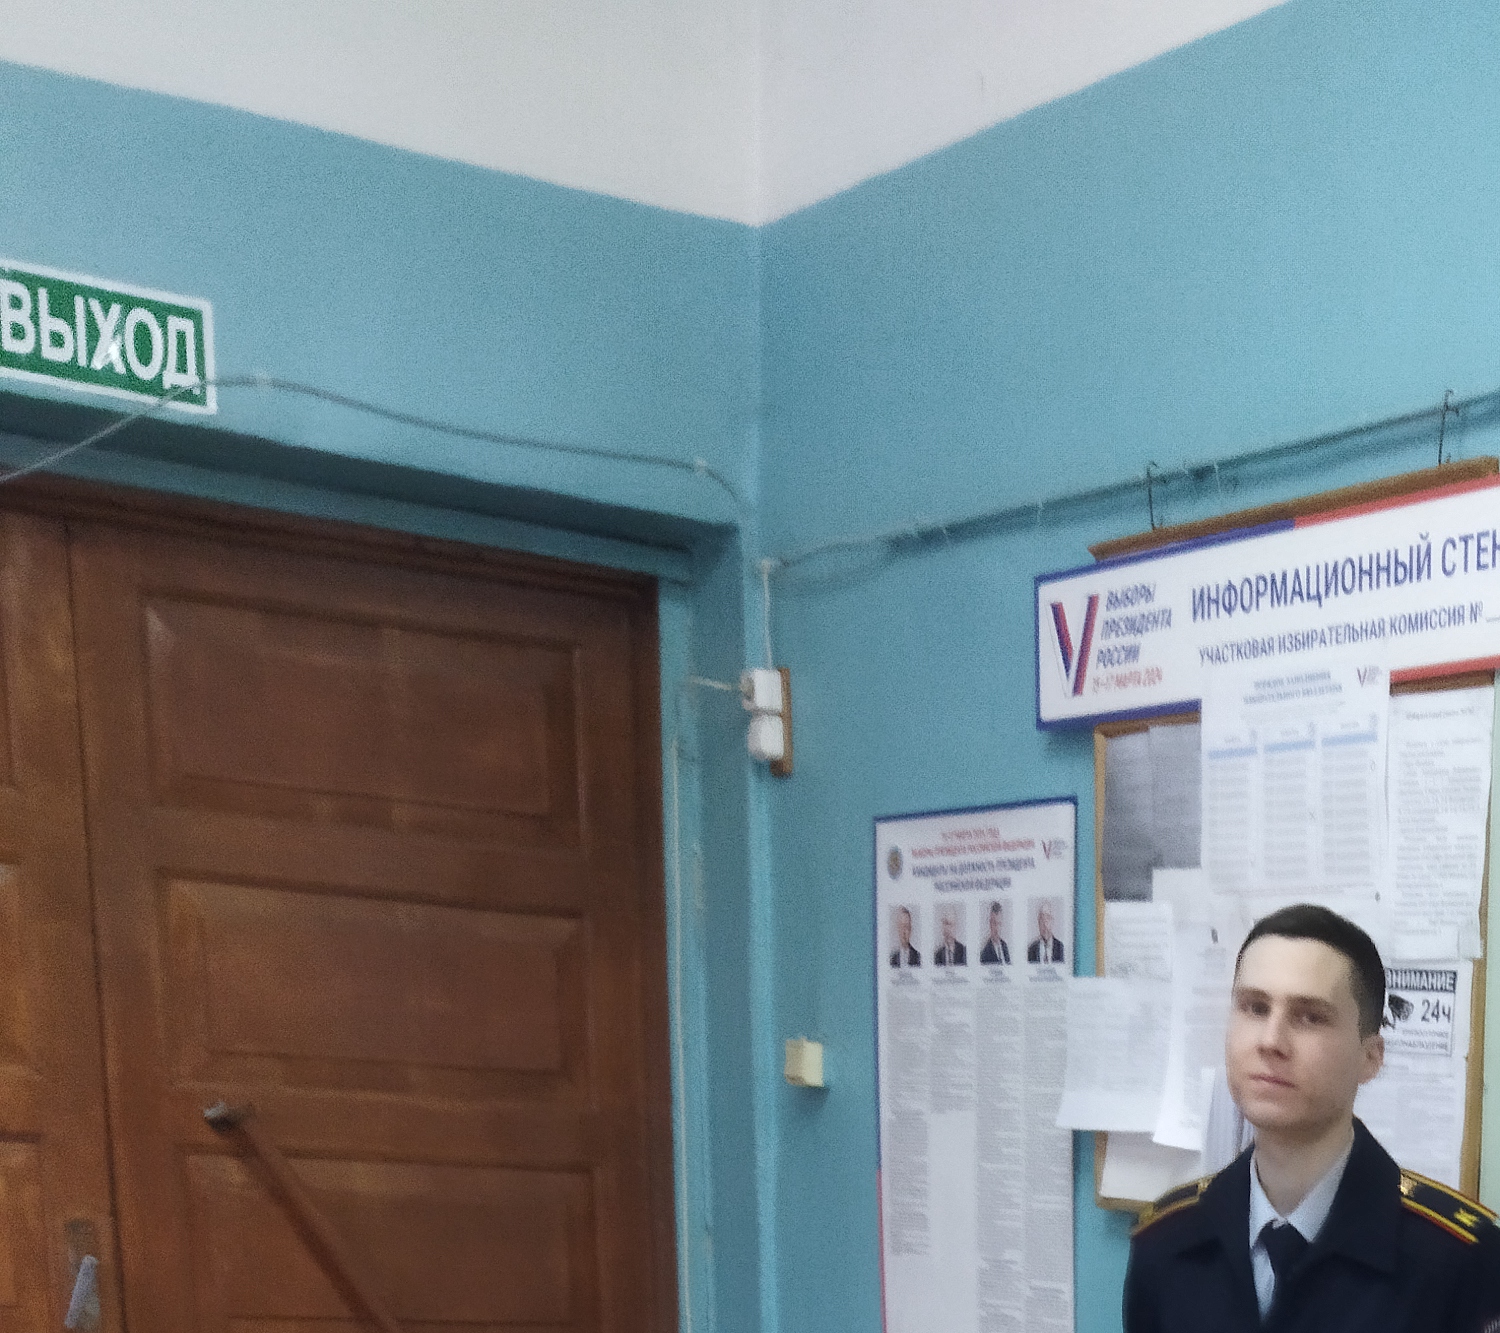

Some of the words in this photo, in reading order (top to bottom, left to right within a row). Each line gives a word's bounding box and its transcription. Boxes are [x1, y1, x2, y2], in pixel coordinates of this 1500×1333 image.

[0, 278, 201, 395] ВЫХОД
[1106, 583, 1157, 612] ВЫБОРЫ
[1191, 532, 1433, 623] ИНФОРМАЦИОННЫЙ
[1101, 608, 1172, 640] ПРЕЗИДЕНТА
[1198, 636, 1276, 667] УЧАСТКОВАЯ
[1278, 618, 1386, 656] ИЗБИРАТЕЛЬНАЯ
[1389, 607, 1466, 637] КОМИССИЯ
[1096, 643, 1142, 669] РОССИИ
